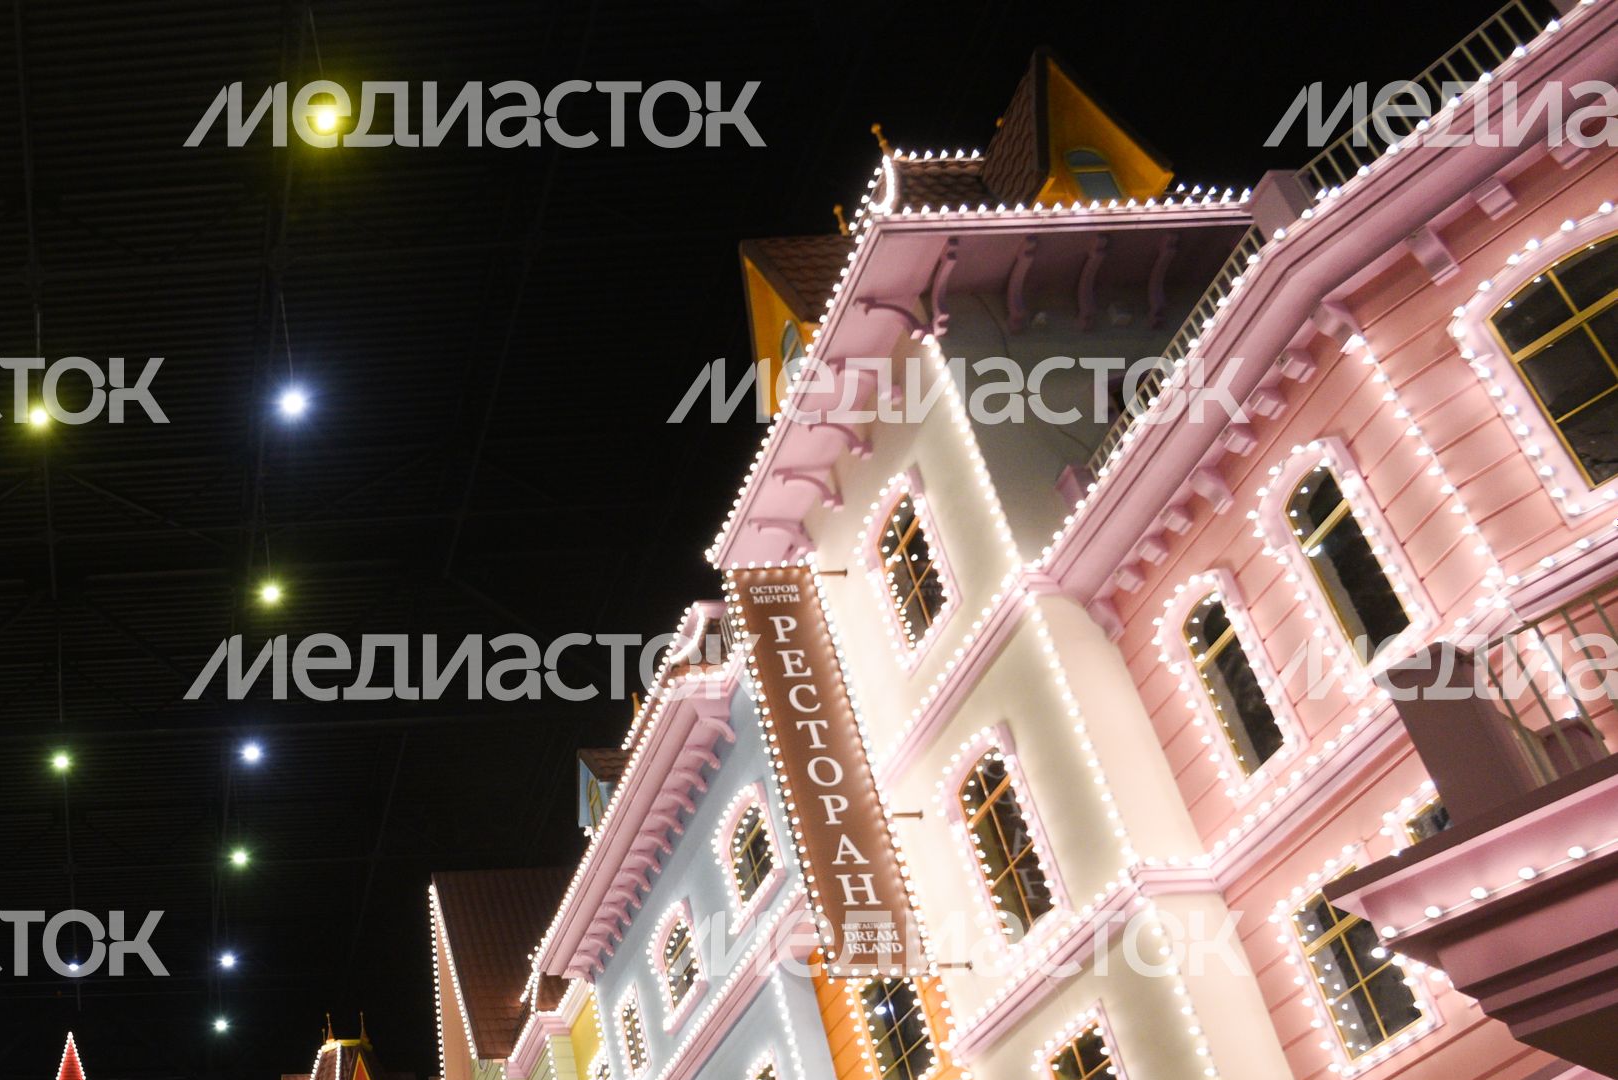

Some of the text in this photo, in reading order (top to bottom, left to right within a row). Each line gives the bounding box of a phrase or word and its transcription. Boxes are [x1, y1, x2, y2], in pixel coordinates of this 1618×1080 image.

[749, 584, 799, 594] ОСТРОВ
[753, 594, 801, 605] МЕЧТЫ
[768, 615, 882, 906] РЕСТОРАН
[844, 930, 900, 942] DREAM
[847, 942, 903, 954] ISLAND
